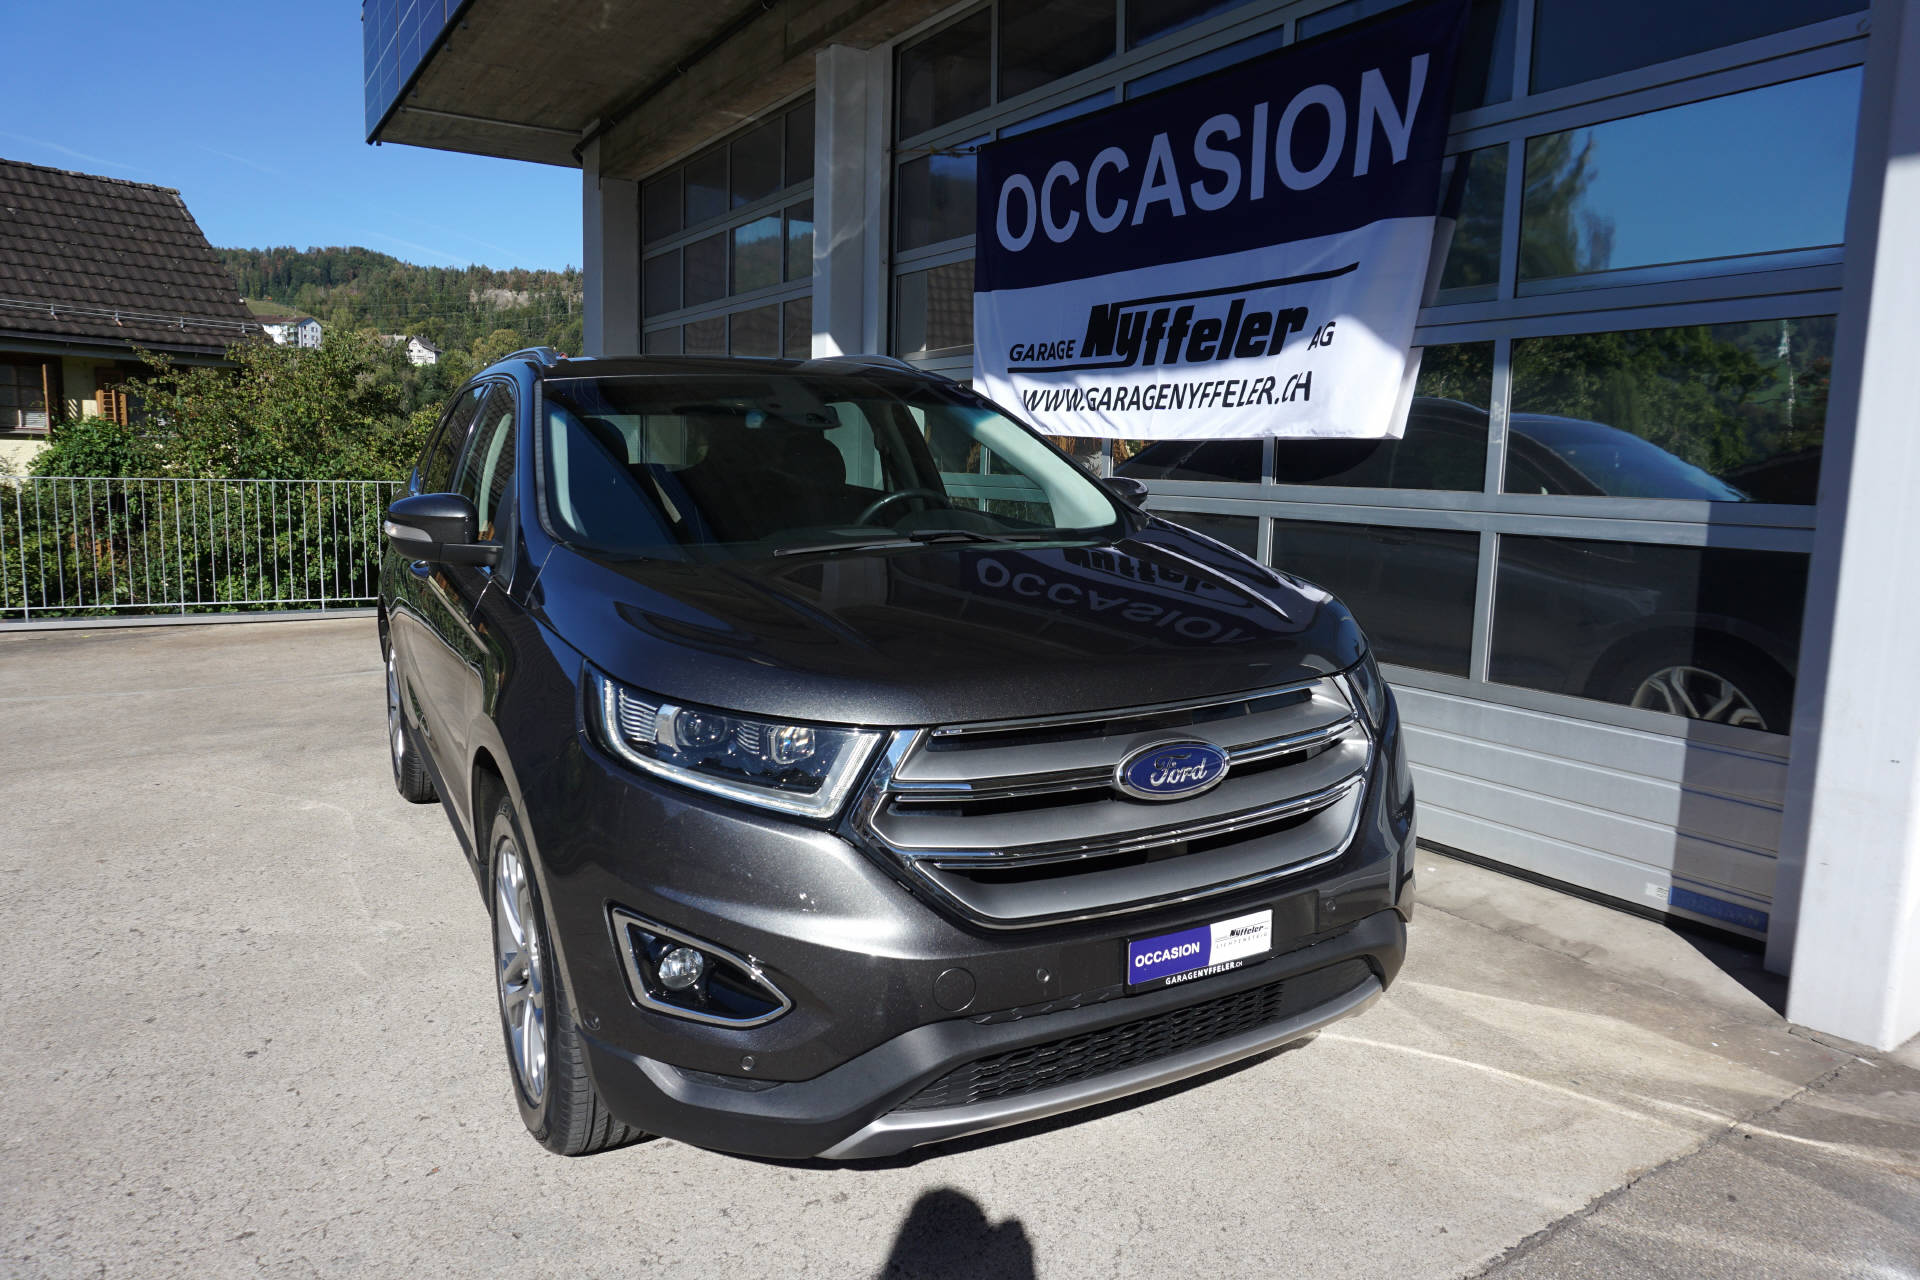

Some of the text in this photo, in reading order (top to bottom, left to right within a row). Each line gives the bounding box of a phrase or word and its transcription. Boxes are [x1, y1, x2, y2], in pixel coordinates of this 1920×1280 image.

[996, 53, 1430, 252] OCCASION
[1009, 298, 1336, 366] GARAGE Nyffeler AG
[1022, 371, 1313, 412] WWW.GARAGENYFFELER.CH
[1150, 753, 1206, 787] Ford
[1135, 942, 1200, 967] OCCASION
[1165, 960, 1243, 985] GARAGENYFFELER.CH
